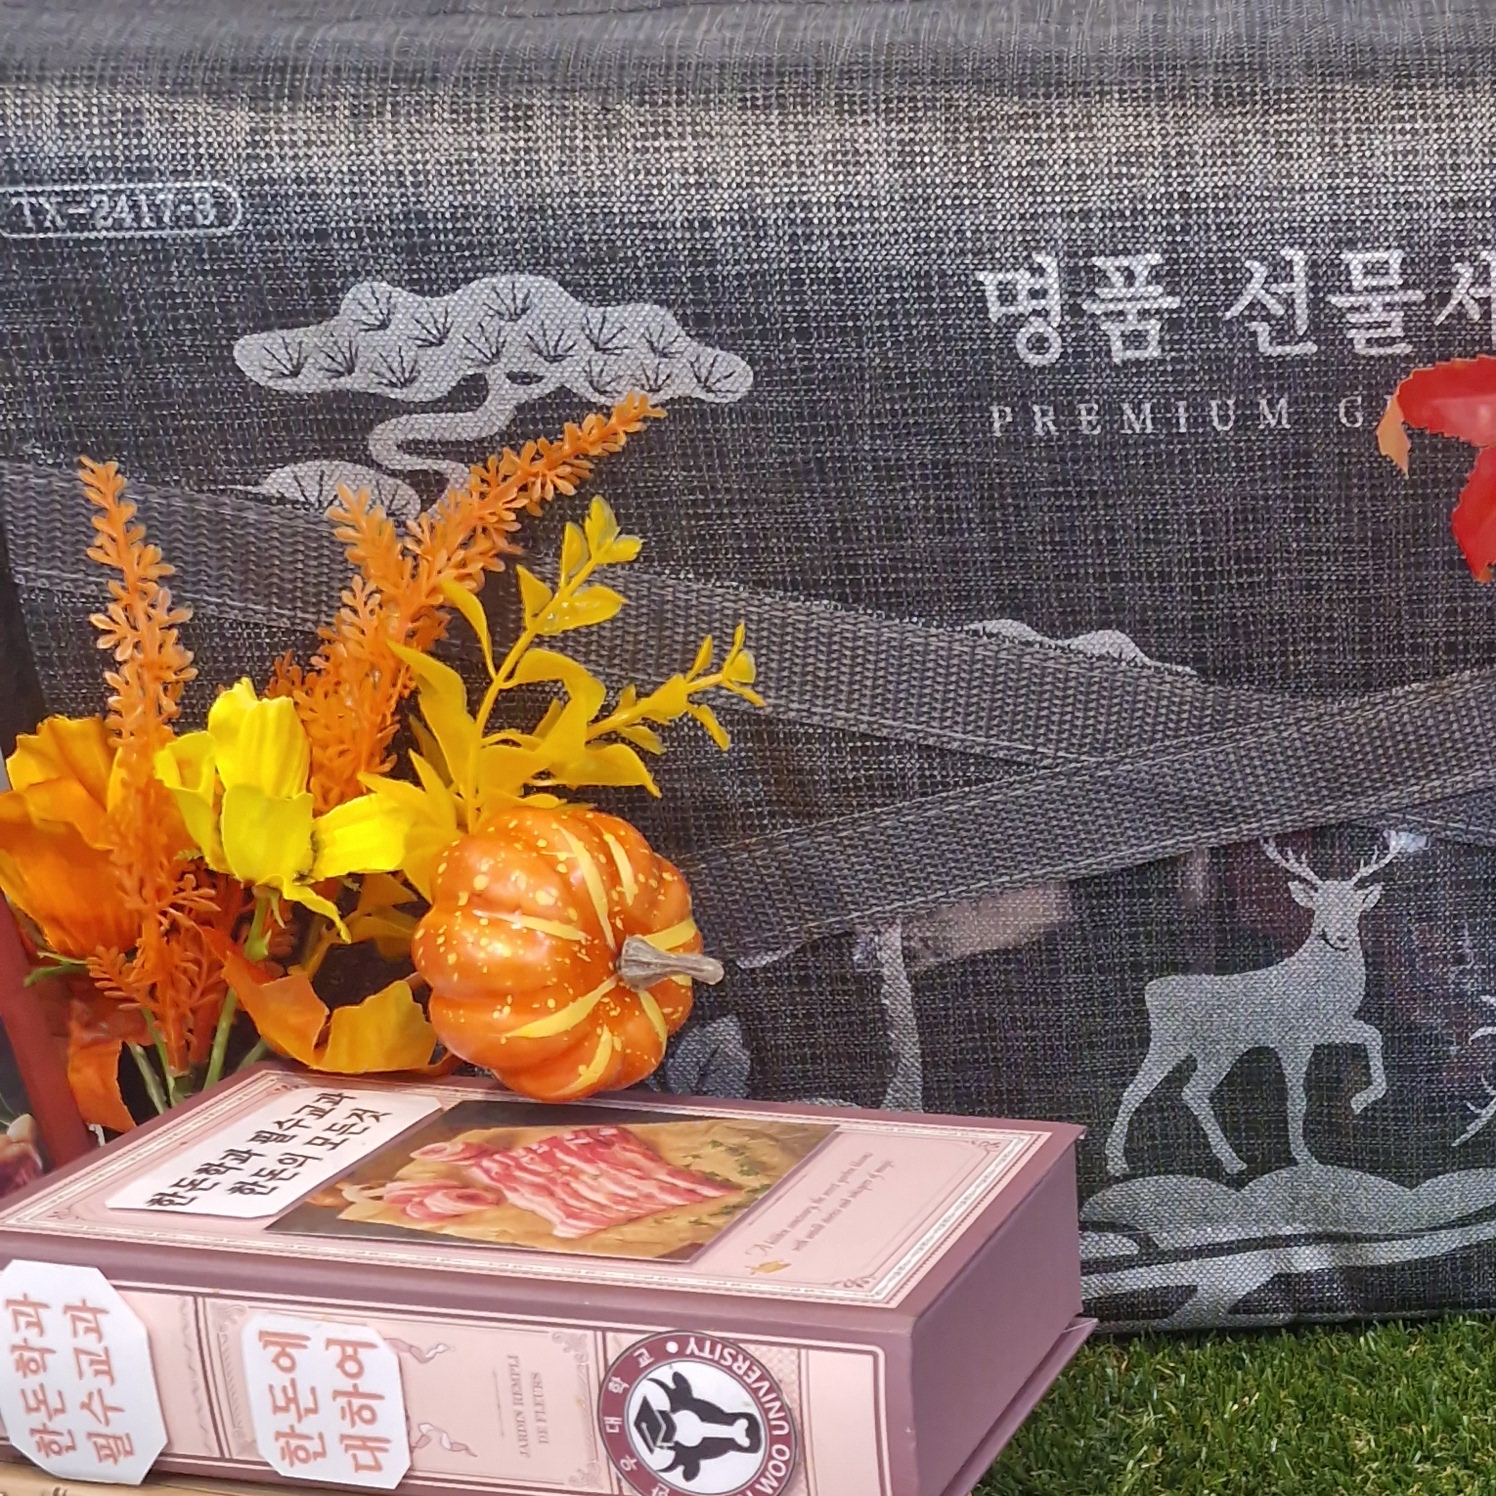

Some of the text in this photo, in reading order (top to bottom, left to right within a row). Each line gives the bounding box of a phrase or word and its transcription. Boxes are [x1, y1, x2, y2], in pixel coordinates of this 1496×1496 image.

[976, 254, 1181, 367] 명품
[993, 397, 1291, 437] PREMIUM
[146, 1092, 356, 1207] 한돈학과 필수교과
[227, 1108, 392, 1195] 한돈의 모든것
[6, 1294, 76, 1459] 한돈학과
[63, 1299, 134, 1465] 필수교과
[258, 1330, 327, 1468] 한돈에
[325, 1337, 392, 1473] 대하여
[685, 1337, 790, 1435] UNIVERSITY
[755, 1444, 790, 1494] WOO
